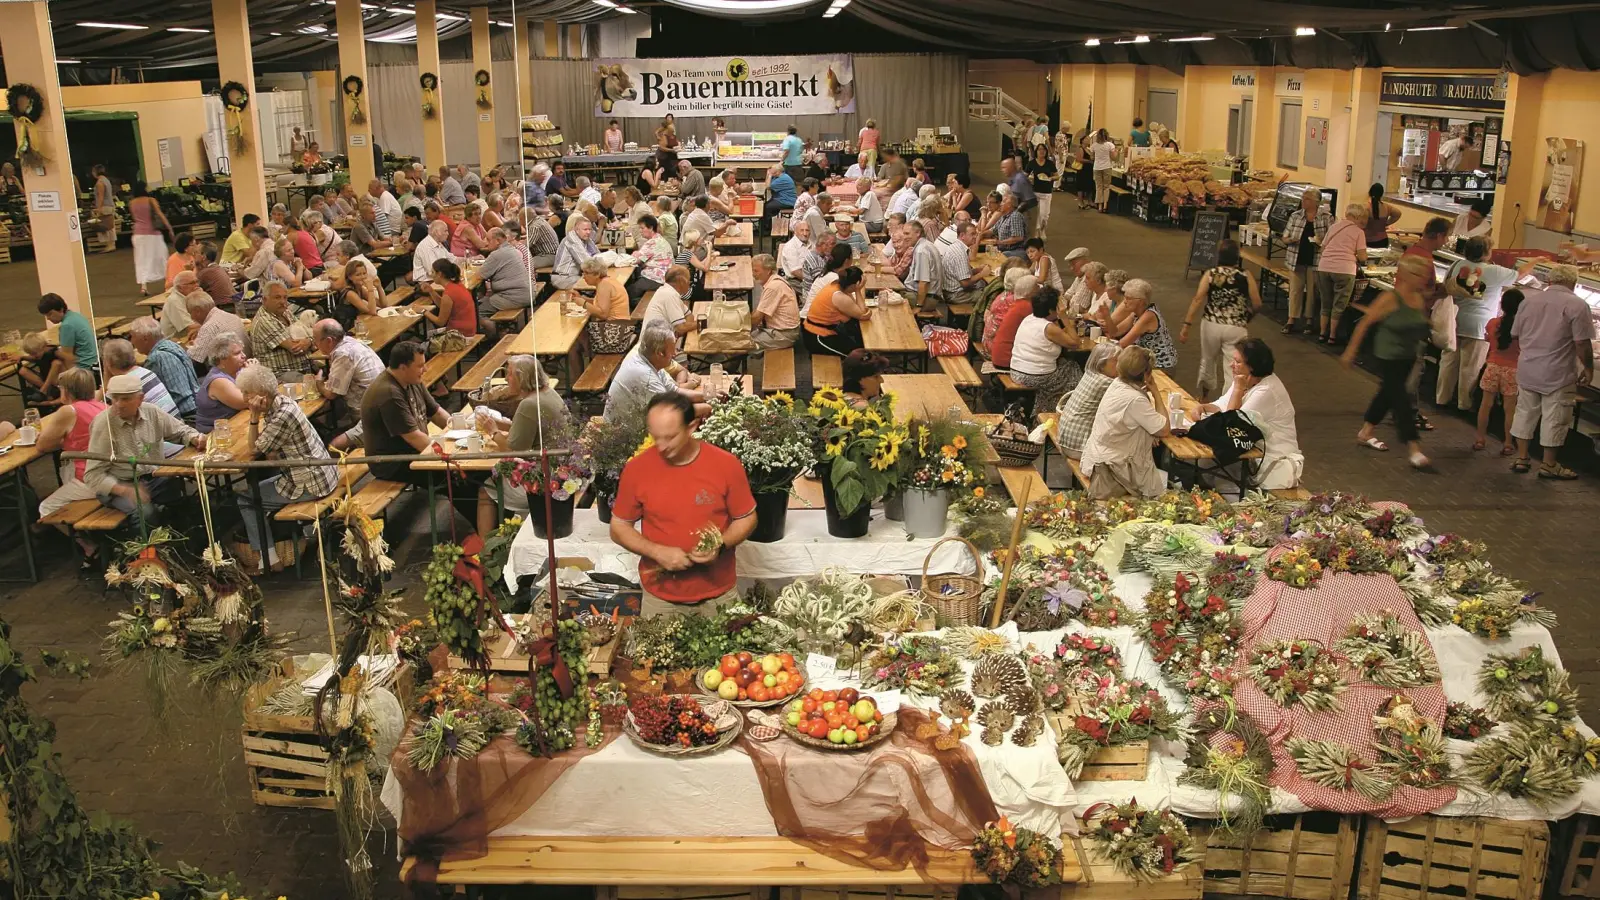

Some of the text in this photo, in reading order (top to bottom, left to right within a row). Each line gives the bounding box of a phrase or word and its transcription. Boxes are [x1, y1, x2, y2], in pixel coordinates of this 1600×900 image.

[666, 69, 682, 78] Das
[683, 69, 705, 78] Team
[751, 63, 790, 76] seit 1992
[639, 72, 820, 105] Bauernmarkt
[1286, 78, 1301, 91] Pizza
[1382, 82, 1438, 97] LANDSHUTER
[1442, 84, 1494, 100] BRAUHAUS
[667, 100, 793, 111] beim biller begrüßt seine Gäste!
